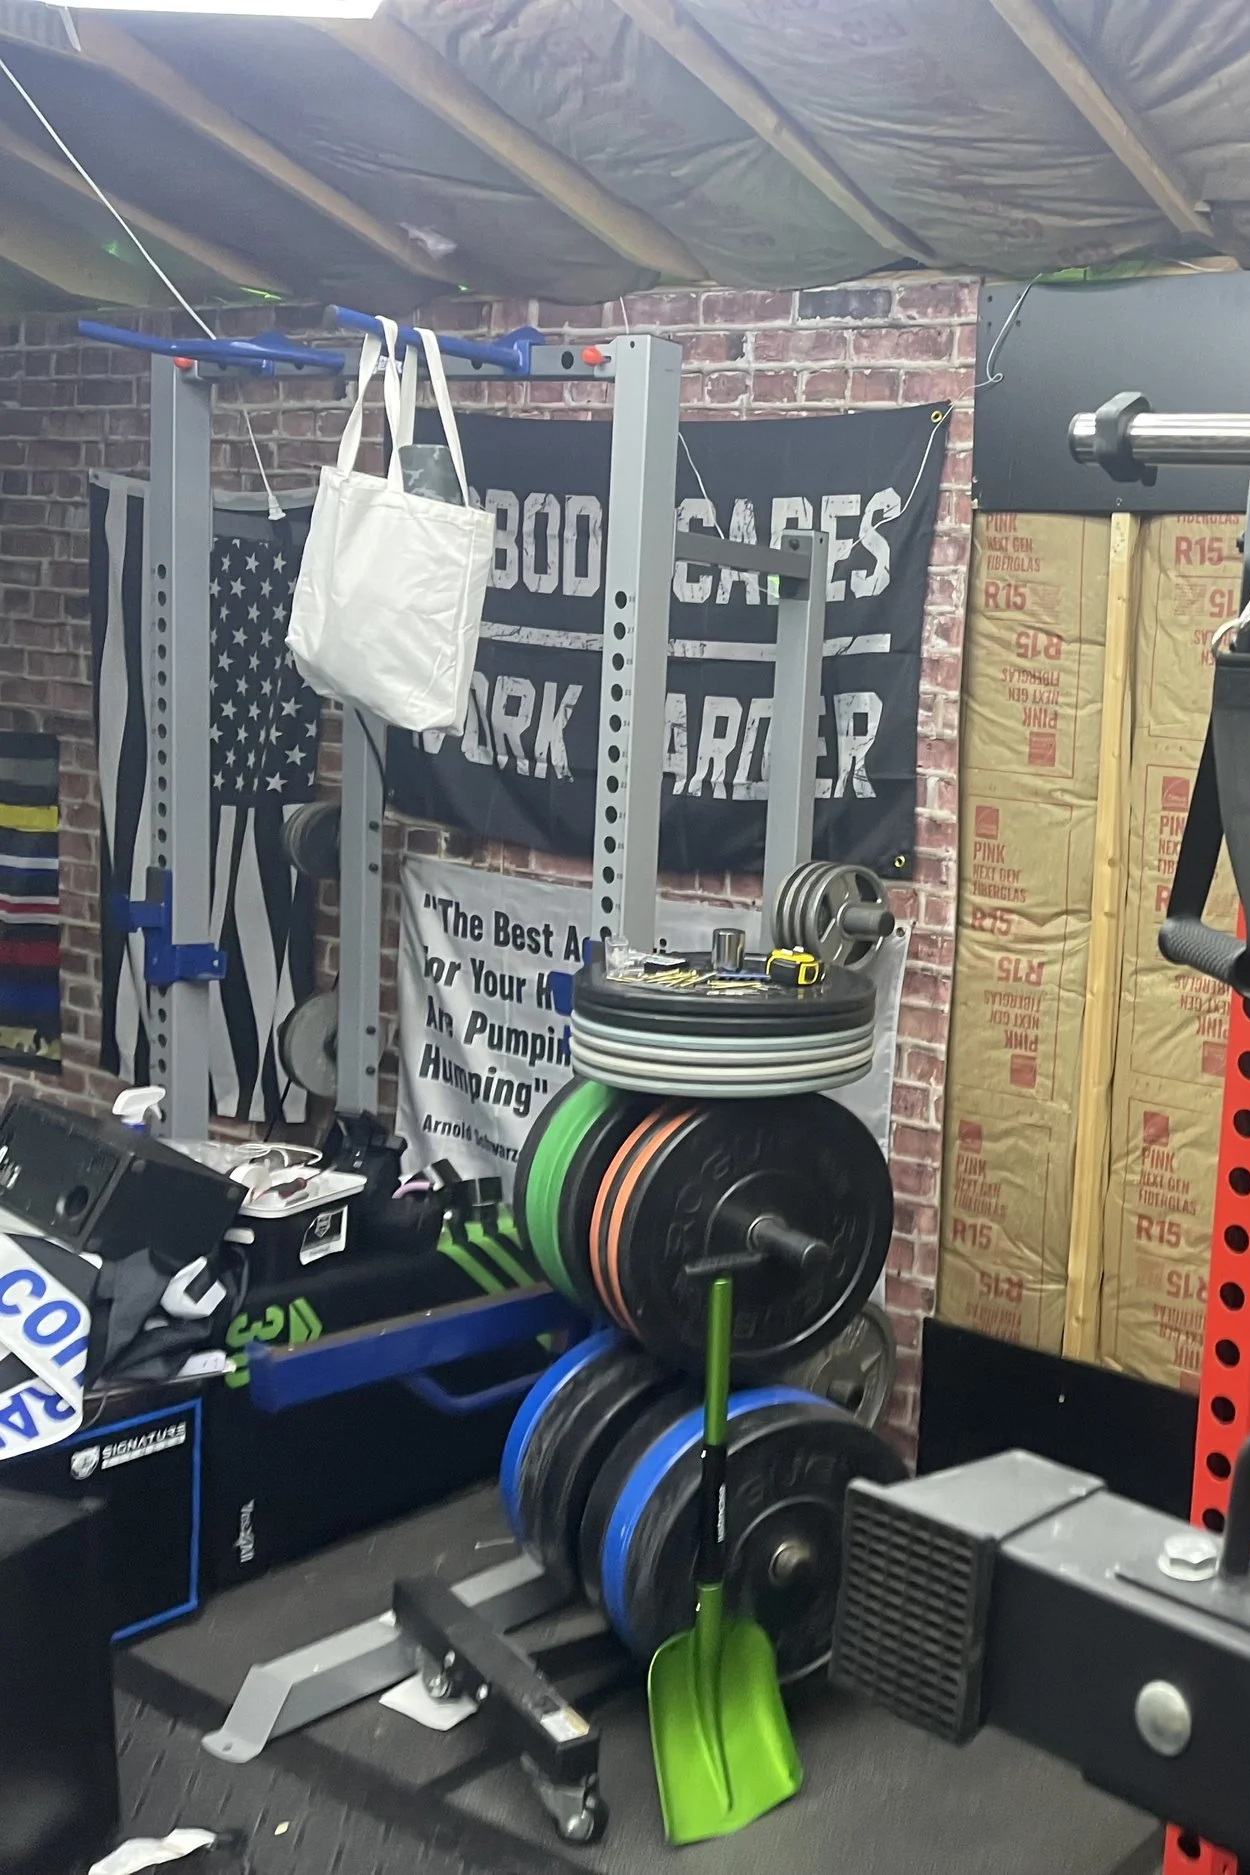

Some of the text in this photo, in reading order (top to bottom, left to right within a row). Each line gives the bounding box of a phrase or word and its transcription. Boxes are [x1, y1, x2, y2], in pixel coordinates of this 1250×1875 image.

[985, 511, 1018, 532] PINK
[469, 486, 602, 597] BOD
[986, 536, 1032, 553] NEXT GEN
[1175, 535, 1224, 566] R15
[987, 555, 1041, 572] FIBERGLAS
[984, 580, 1026, 611] R15
[1209, 588, 1237, 618] 15
[1016, 630, 1062, 660] R15
[1001, 666, 1060, 687] FIBERGLAS
[412, 670, 584, 783] ORK
[1023, 706, 1059, 729] PINK
[1160, 815, 1185, 837] PIN
[974, 841, 1005, 864] PINK
[1158, 839, 1181, 857] NEX
[423, 893, 484, 942] "The
[494, 910, 553, 958] Best
[470, 957, 527, 1004] Your
[997, 956, 1045, 987] R15
[464, 1010, 571, 1067] Pumpin
[1004, 1029, 1039, 1053] PINK
[419, 1043, 548, 1118] Humping"
[422, 1114, 472, 1142] Arnold
[1142, 1146, 1175, 1173] PINK
[952, 1218, 993, 1250] R15
[1136, 1214, 1181, 1249] R15
[102, 1421, 187, 1460] SIGNATURE
